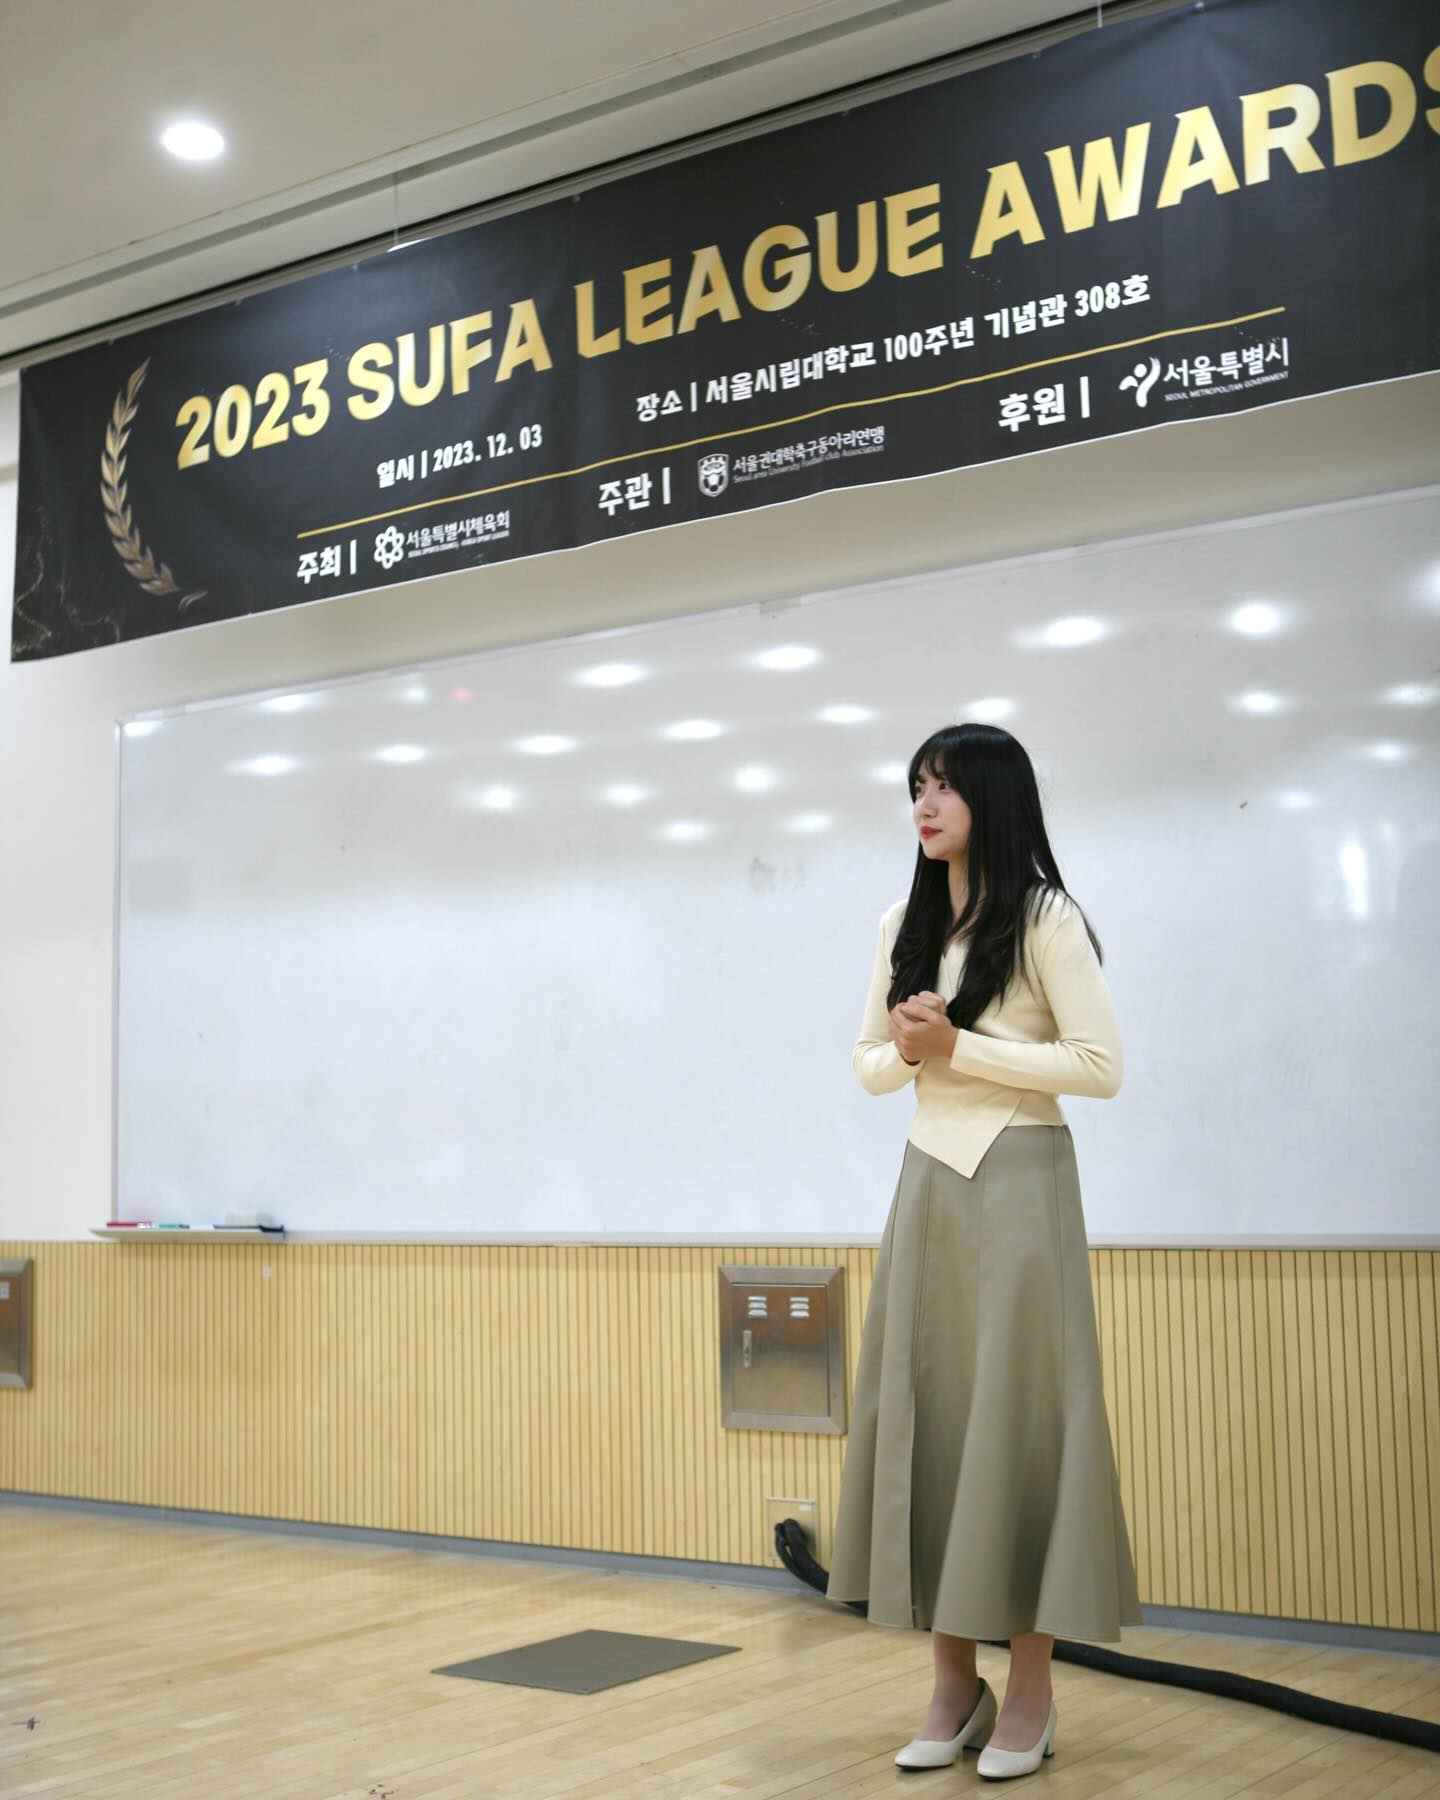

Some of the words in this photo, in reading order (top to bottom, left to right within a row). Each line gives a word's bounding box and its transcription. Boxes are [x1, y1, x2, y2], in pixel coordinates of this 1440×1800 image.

[175, 358, 331, 470] 2023
[347, 299, 553, 420] SUFA
[574, 182, 944, 359] LEAGUE
[636, 390, 683, 422] 장소
[705, 341, 877, 404] 서울시립대학교
[883, 316, 975, 363] 100주년
[984, 293, 1068, 338] 기념관
[1075, 273, 1151, 317] 308호
[1163, 337, 1289, 387] 서울특별시
[998, 383, 1066, 432] 후원
[376, 453, 415, 489] 일시
[432, 440, 483, 473] 2023.
[487, 432, 514, 459] 12.
[519, 423, 543, 450] 03
[733, 425, 885, 473] 서울권대학축구동아리연맹
[597, 472, 653, 516] 주관
[406, 510, 510, 549] 서울특별시체육회
[296, 544, 341, 584] 주최
